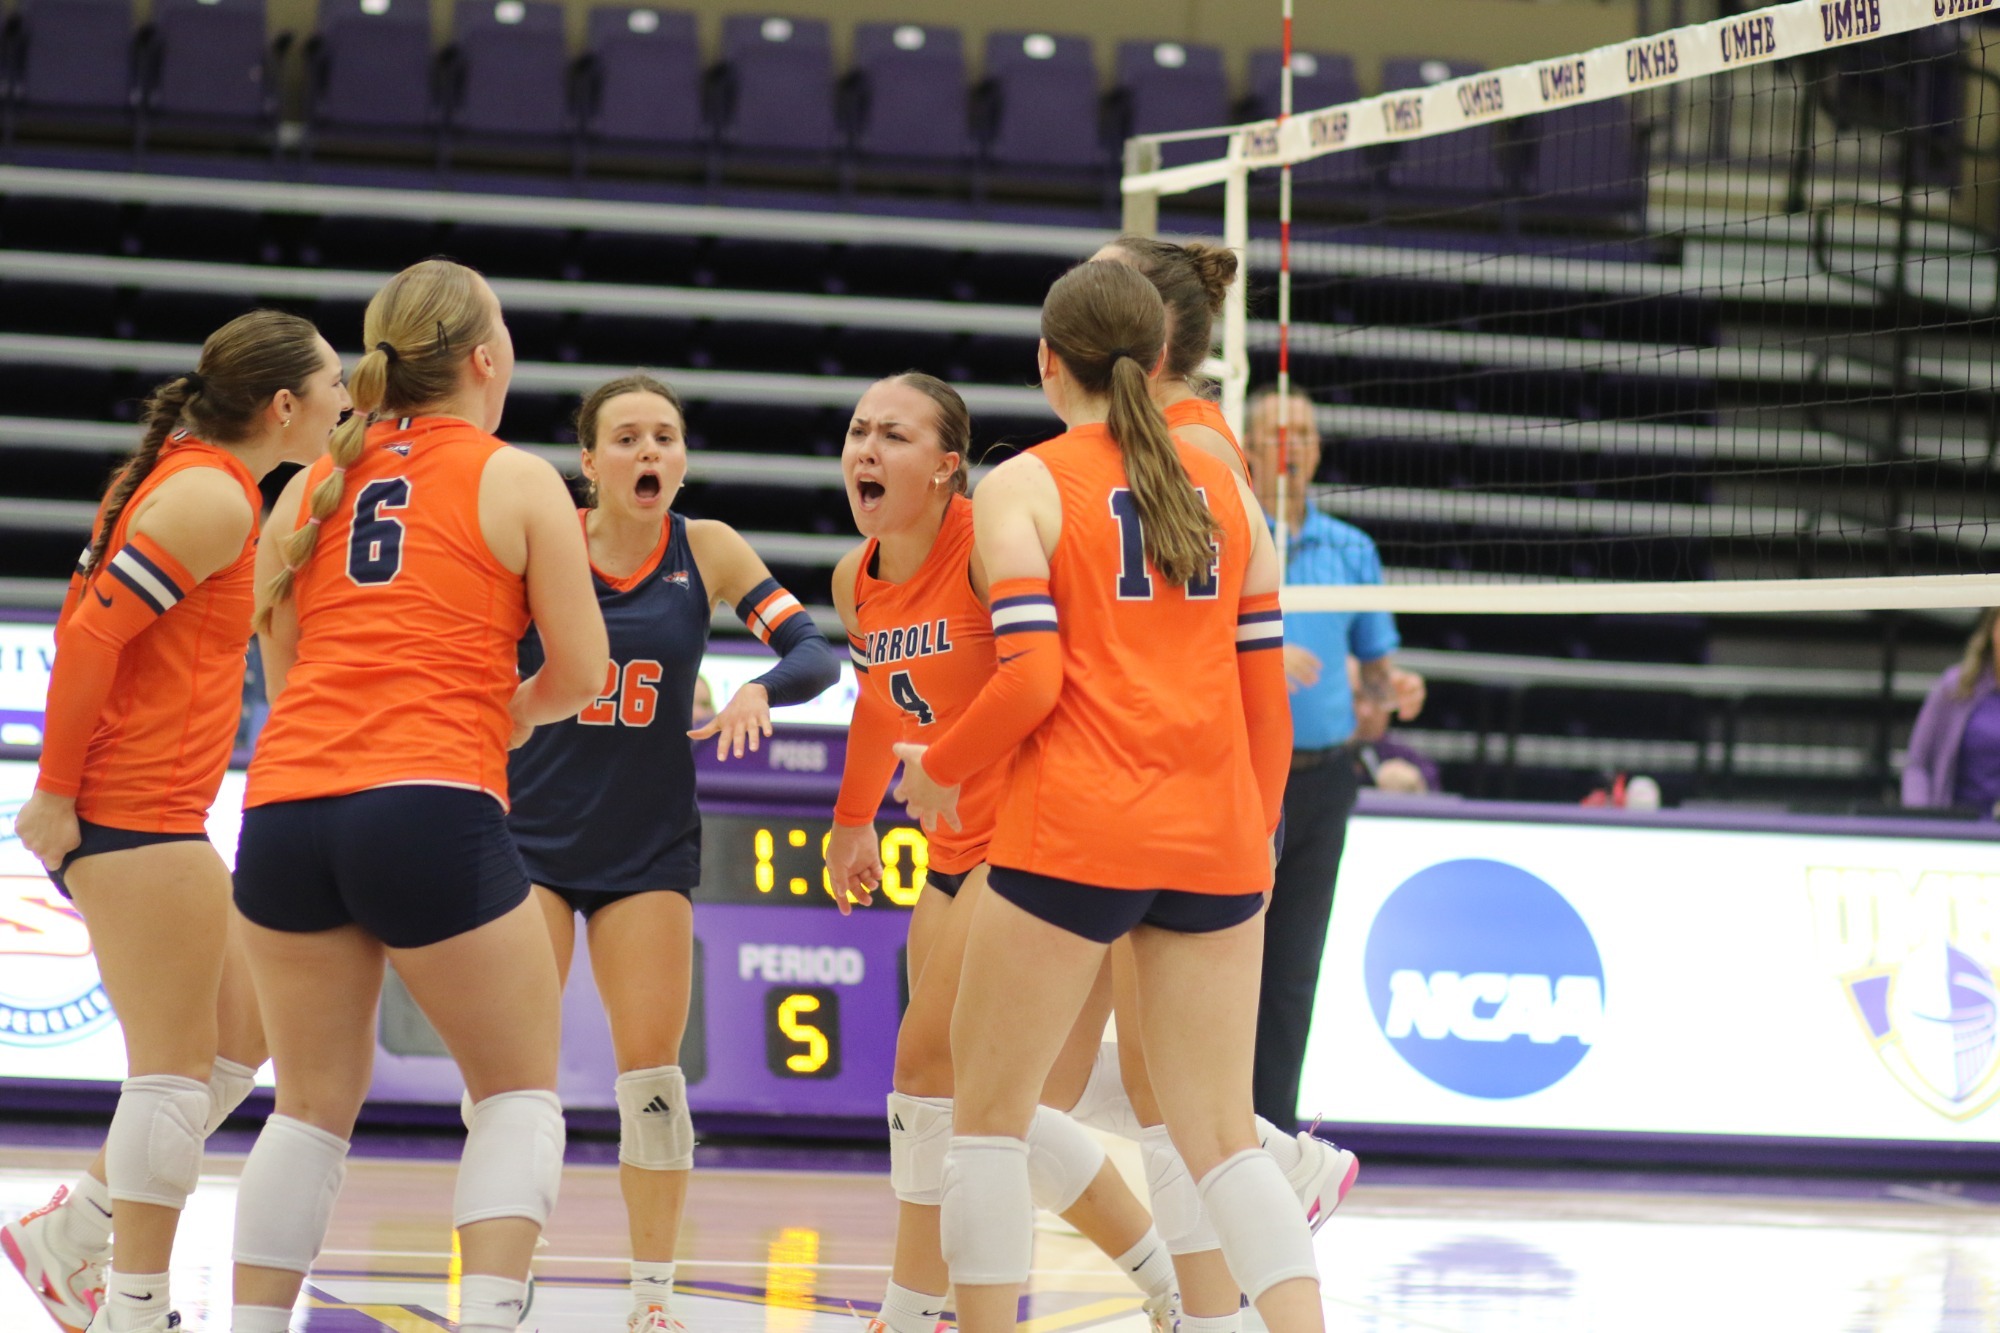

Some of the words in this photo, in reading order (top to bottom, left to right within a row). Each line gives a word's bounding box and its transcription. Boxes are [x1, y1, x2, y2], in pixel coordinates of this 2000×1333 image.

[1539, 60, 1585, 101] UMHB
[1626, 38, 1678, 83] UMHB
[1720, 16, 1776, 63] UMHB
[1821, 0, 1881, 42] UMHB
[346, 475, 412, 587] 6
[865, 618, 952, 666] ARROLL
[578, 659, 663, 727] 26
[889, 669, 937, 727] 4
[755, 827, 929, 905] 1:0
[738, 943, 866, 985] PERIOD
[778, 994, 829, 1073] 5
[1386, 970, 1602, 1045] NCAA
